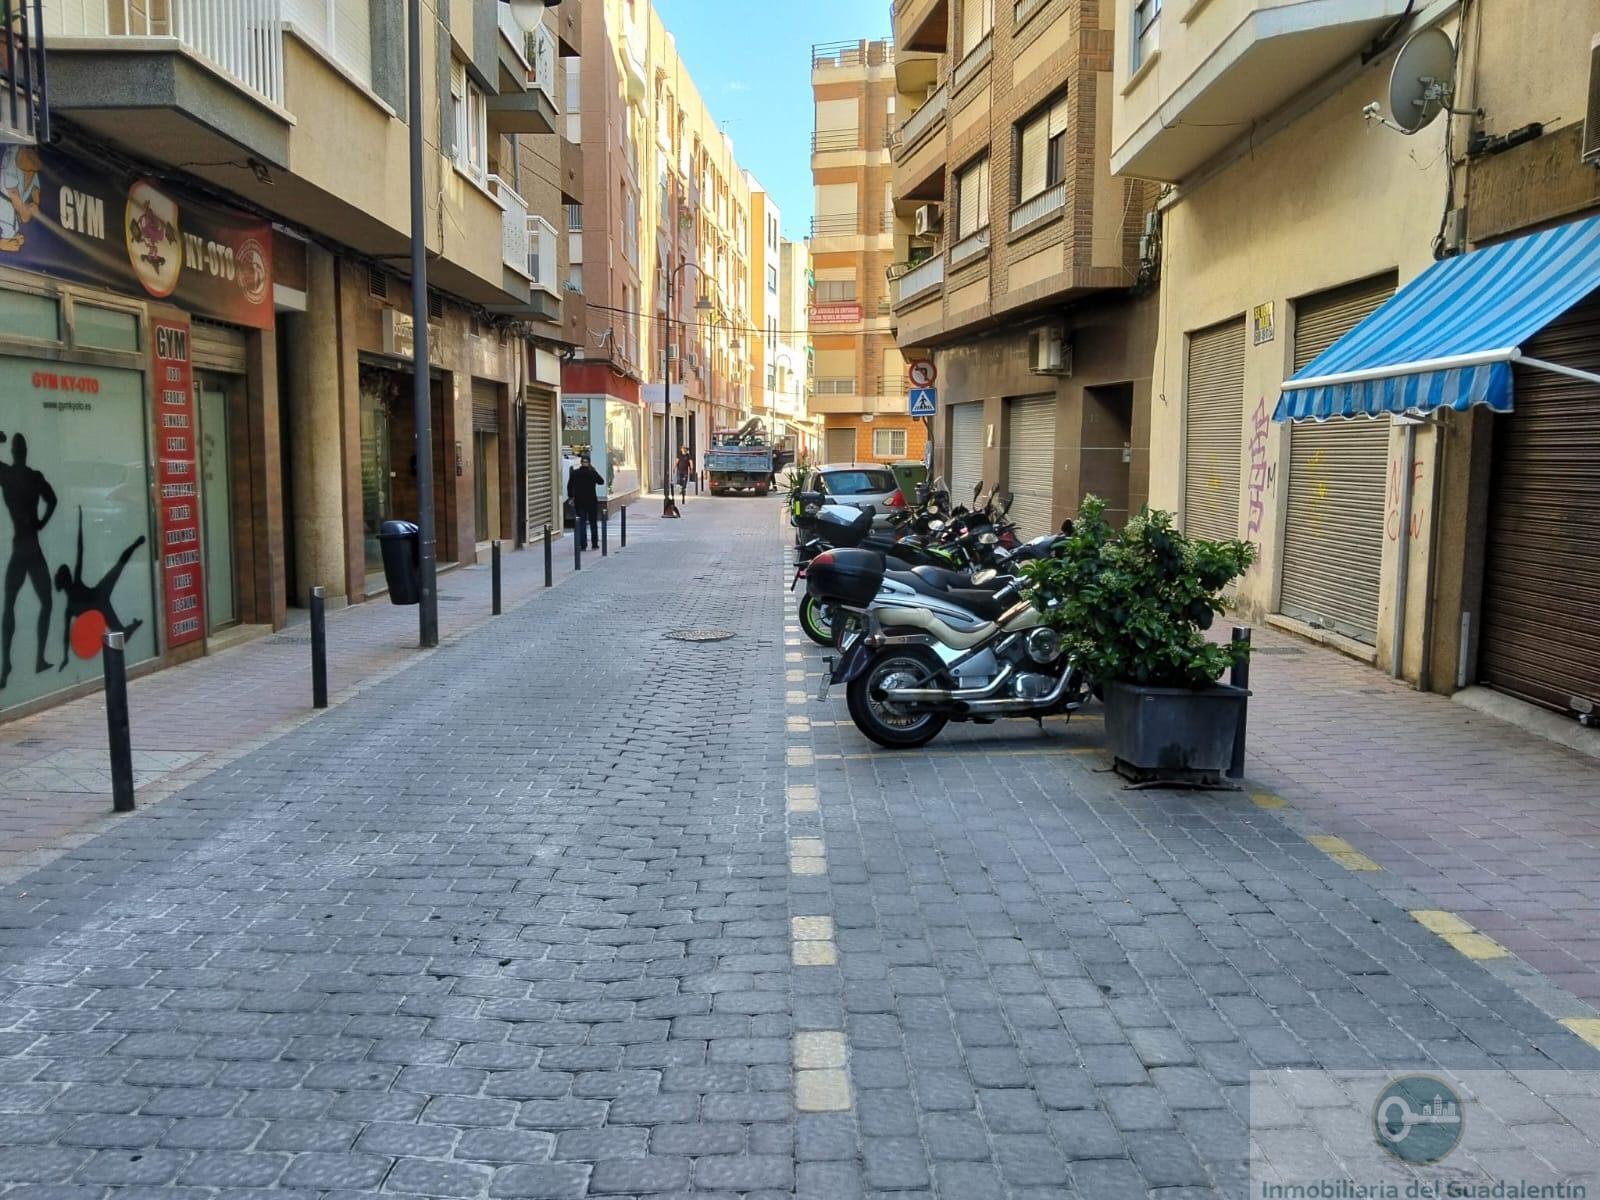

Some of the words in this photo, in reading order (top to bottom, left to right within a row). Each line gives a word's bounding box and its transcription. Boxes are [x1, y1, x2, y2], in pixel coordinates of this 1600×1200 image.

[58, 185, 105, 240] GYM
[183, 232, 236, 281] KY-OTO
[155, 325, 187, 362] GYM
[32, 371, 58, 390] GYM
[61, 374, 99, 394] KY-OTO
